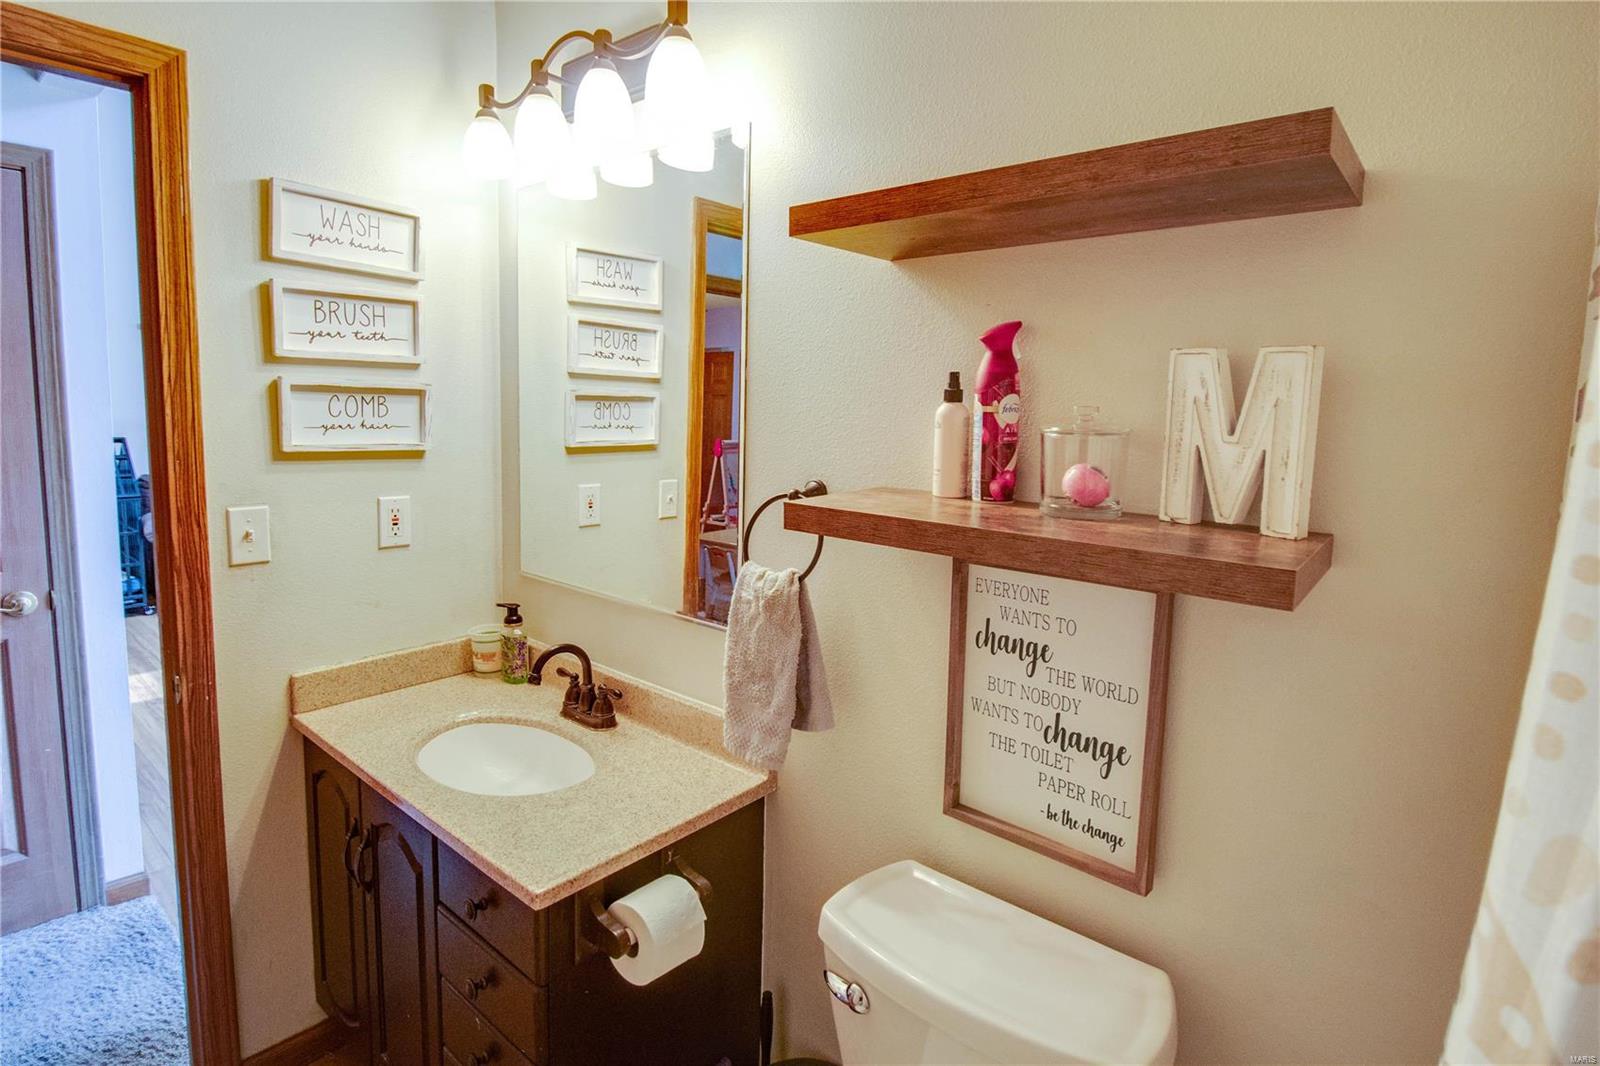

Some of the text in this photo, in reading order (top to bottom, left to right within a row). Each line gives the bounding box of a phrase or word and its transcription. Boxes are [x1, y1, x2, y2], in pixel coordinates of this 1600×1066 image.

[320, 204, 381, 240] WASH
[305, 232, 391, 254] your hands
[314, 299, 386, 328] BRUSH
[305, 330, 390, 344] your teeth
[328, 394, 389, 418] COMB
[319, 420, 393, 436] your hair
[1159, 345, 1325, 541] M
[975, 577, 1050, 606] EVERYONE
[1000, 605, 1077, 636] WANTS TO
[975, 617, 1054, 678] change
[987, 675, 1081, 715] BUT NOBODY
[1046, 666, 1139, 705] THE WORLD
[971, 696, 1132, 779] WANTS TO change
[988, 731, 1074, 773] THE TOILET
[1038, 772, 1132, 820] PAPER ROLL
[1062, 809, 1080, 831] the
[1082, 818, 1126, 853] change
